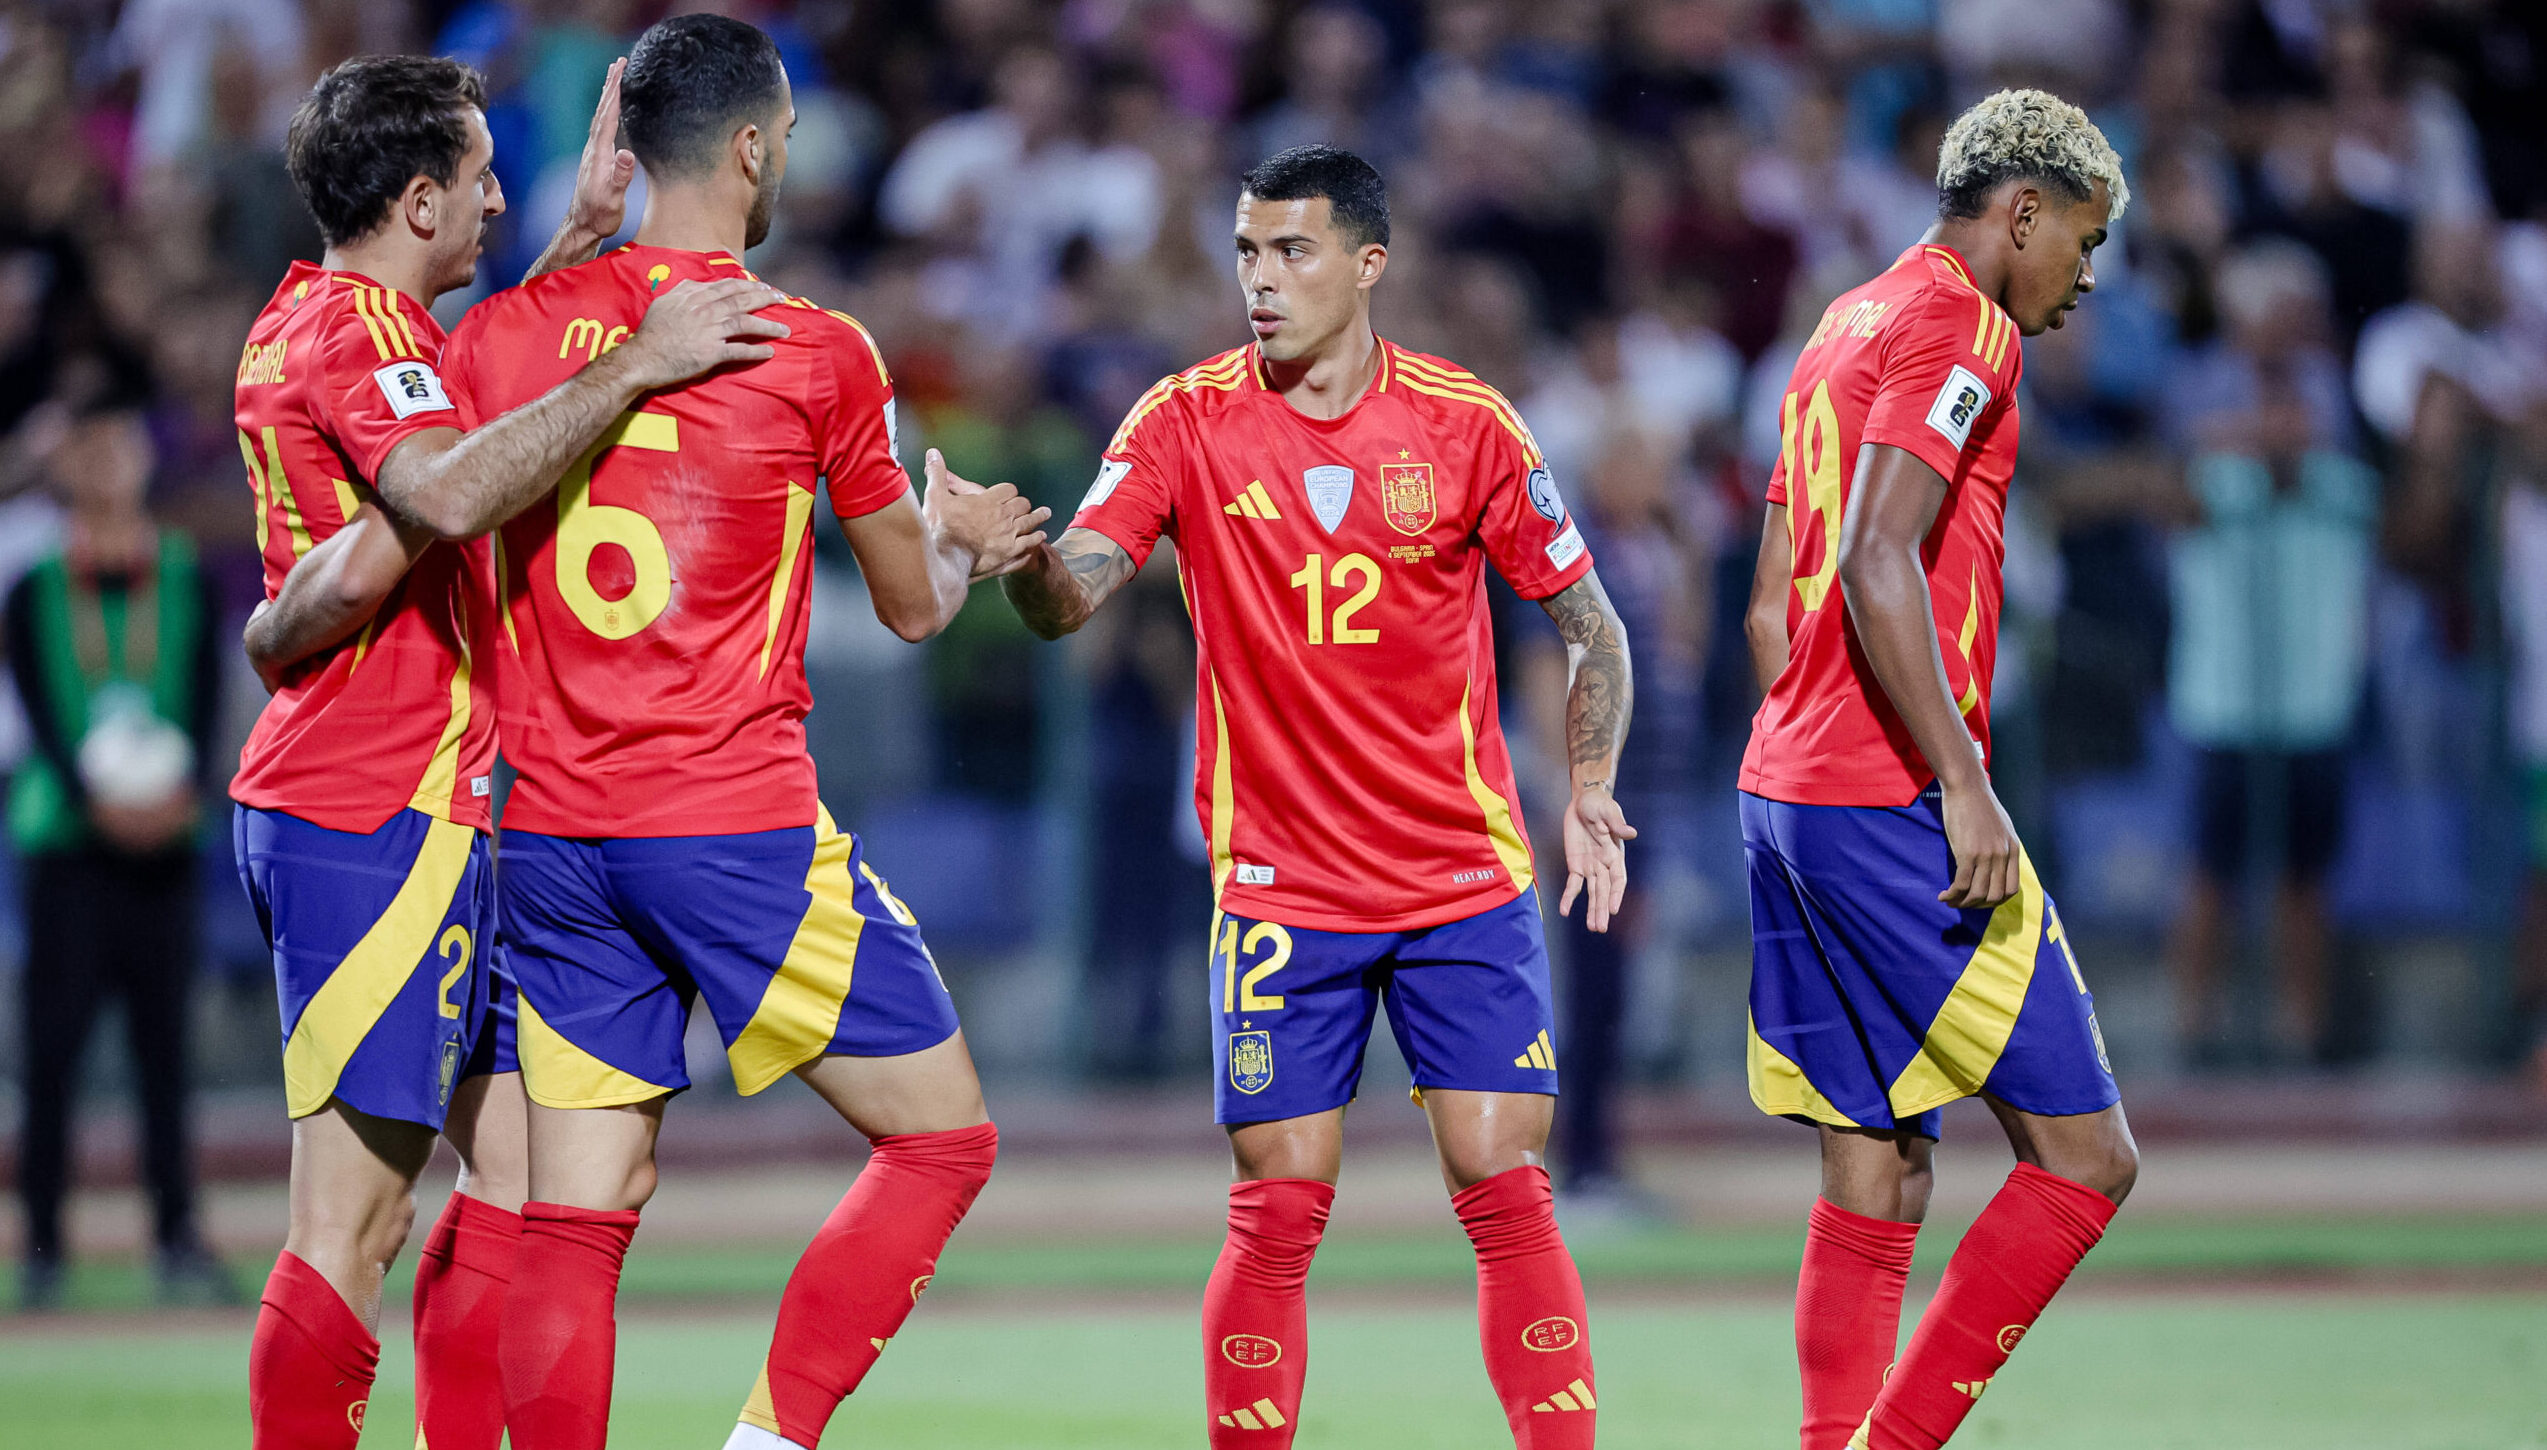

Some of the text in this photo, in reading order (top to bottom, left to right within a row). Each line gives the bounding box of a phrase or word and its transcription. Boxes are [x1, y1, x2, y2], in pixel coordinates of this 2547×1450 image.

[559, 318, 636, 361] ME
[555, 411, 680, 640] 6
[1782, 378, 1841, 612] 19
[1290, 552, 1382, 645] 12
[1453, 869, 1495, 884] HEAT.RDY
[438, 924, 477, 1020] 2
[1219, 920, 1293, 1013] 12
